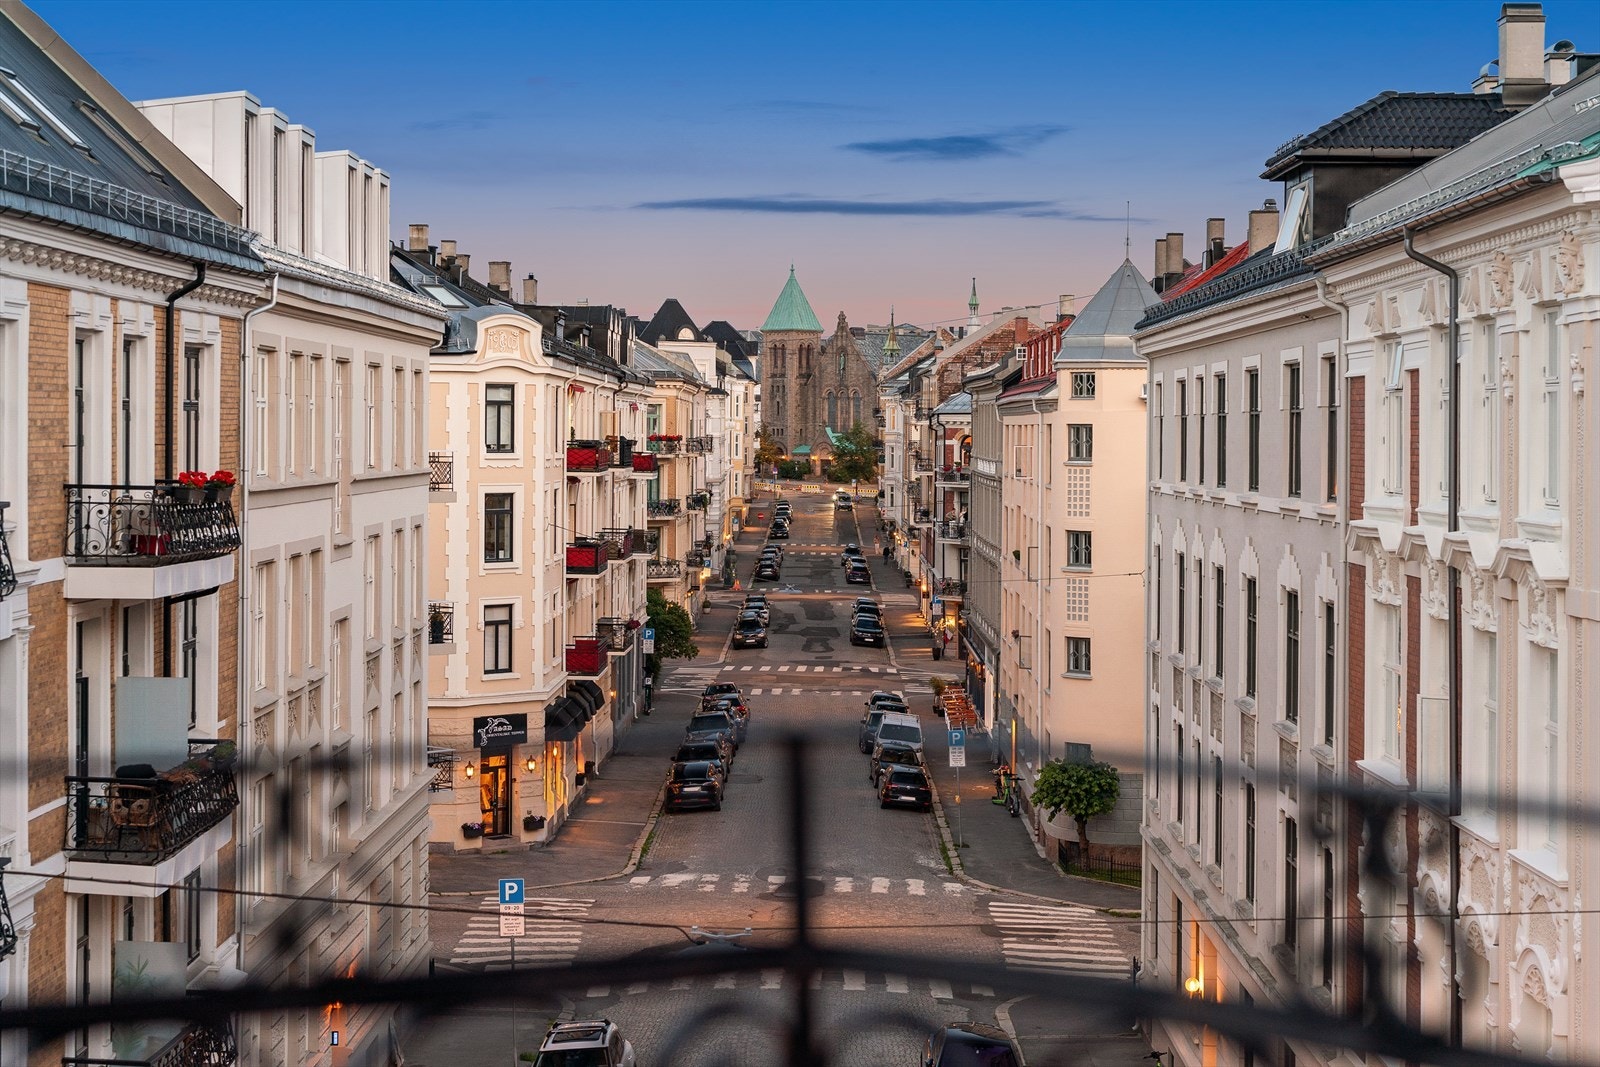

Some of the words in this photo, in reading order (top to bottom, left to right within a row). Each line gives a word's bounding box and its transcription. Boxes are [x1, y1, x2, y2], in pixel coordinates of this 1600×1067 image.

[646, 630, 652, 638] P
[952, 732, 960, 744] P
[504, 882, 518, 901] P
